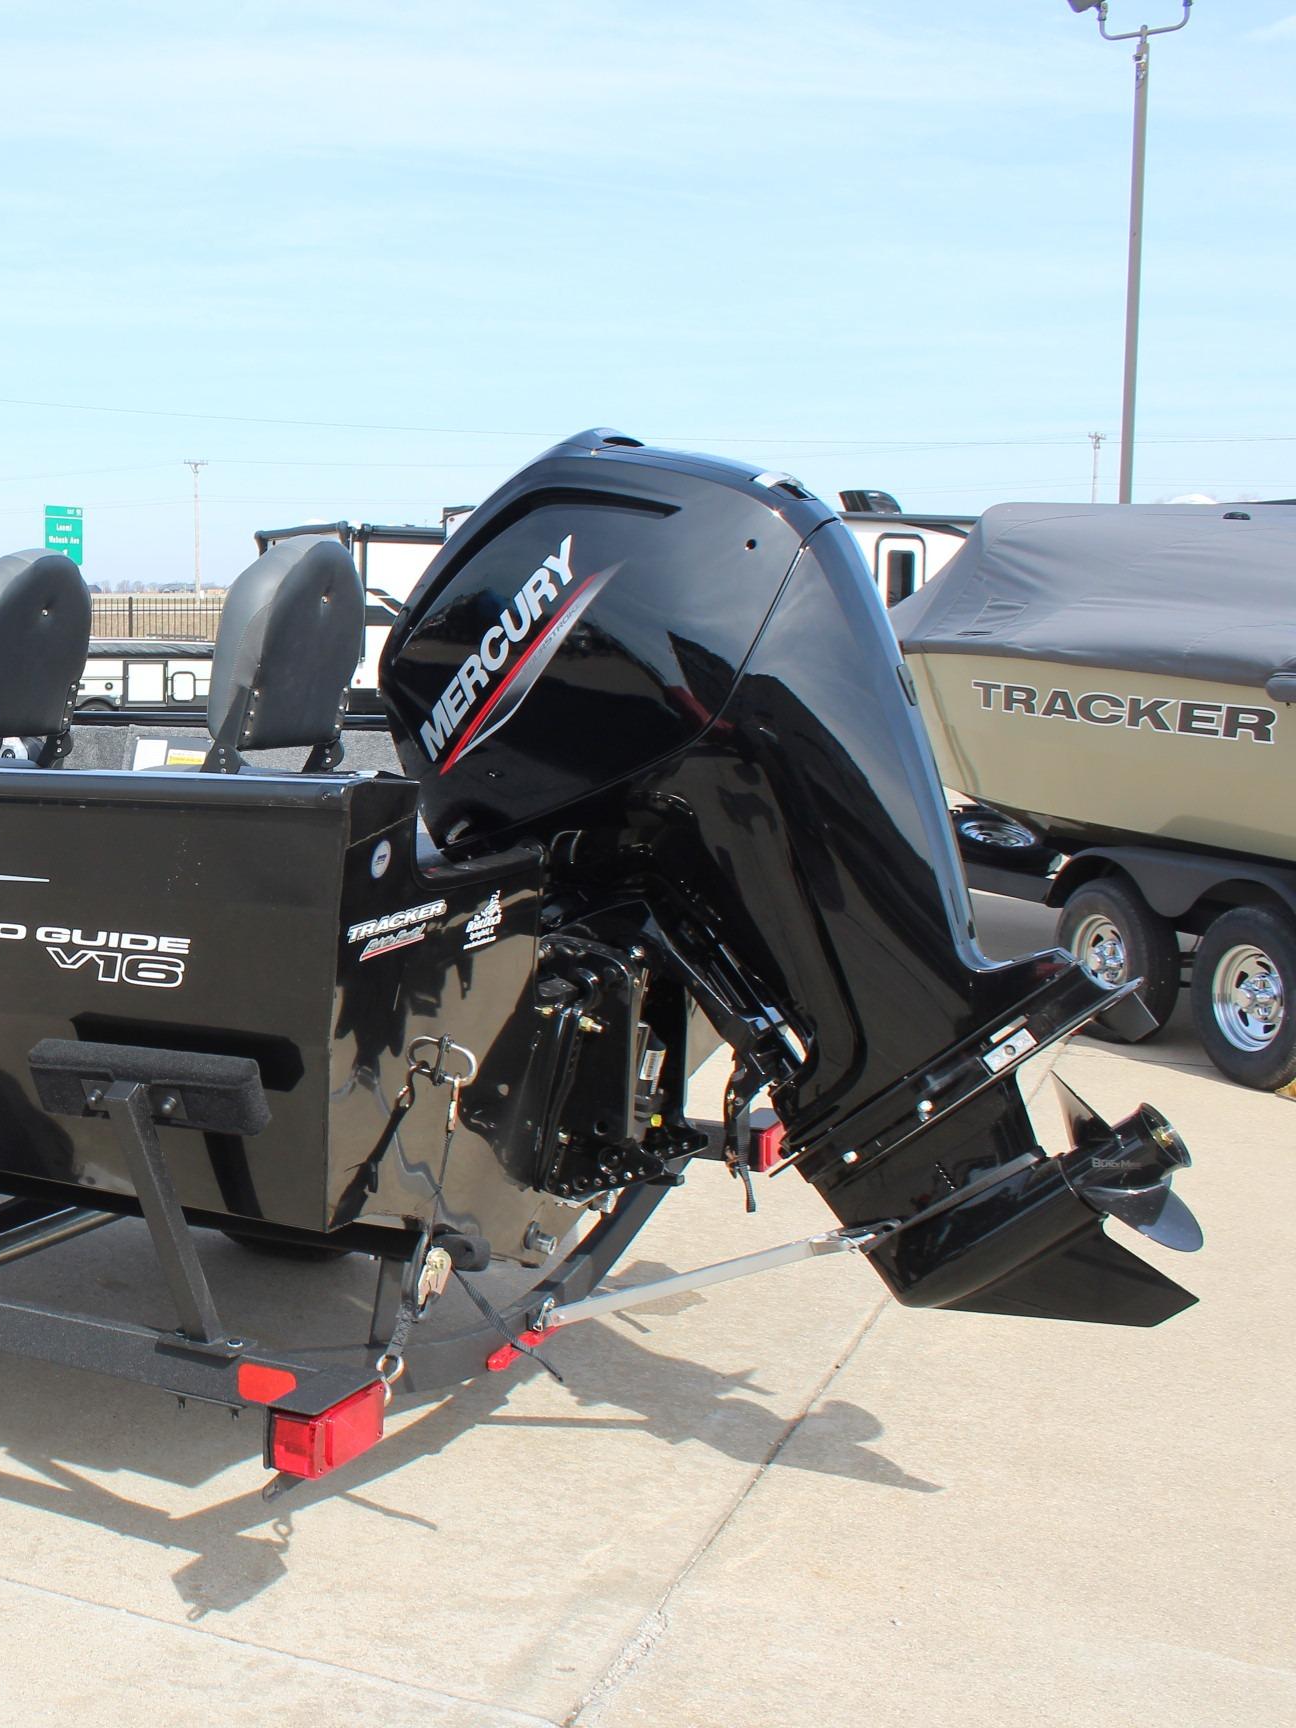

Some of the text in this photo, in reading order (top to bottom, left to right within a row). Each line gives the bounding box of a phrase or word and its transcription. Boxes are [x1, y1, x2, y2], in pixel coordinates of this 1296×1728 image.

[419, 534, 573, 762] MERCURY
[972, 680, 1277, 744] TRACKER
[35, 926, 191, 954] GUIDE
[347, 899, 447, 944] TRACKER
[46, 946, 185, 988] V16
